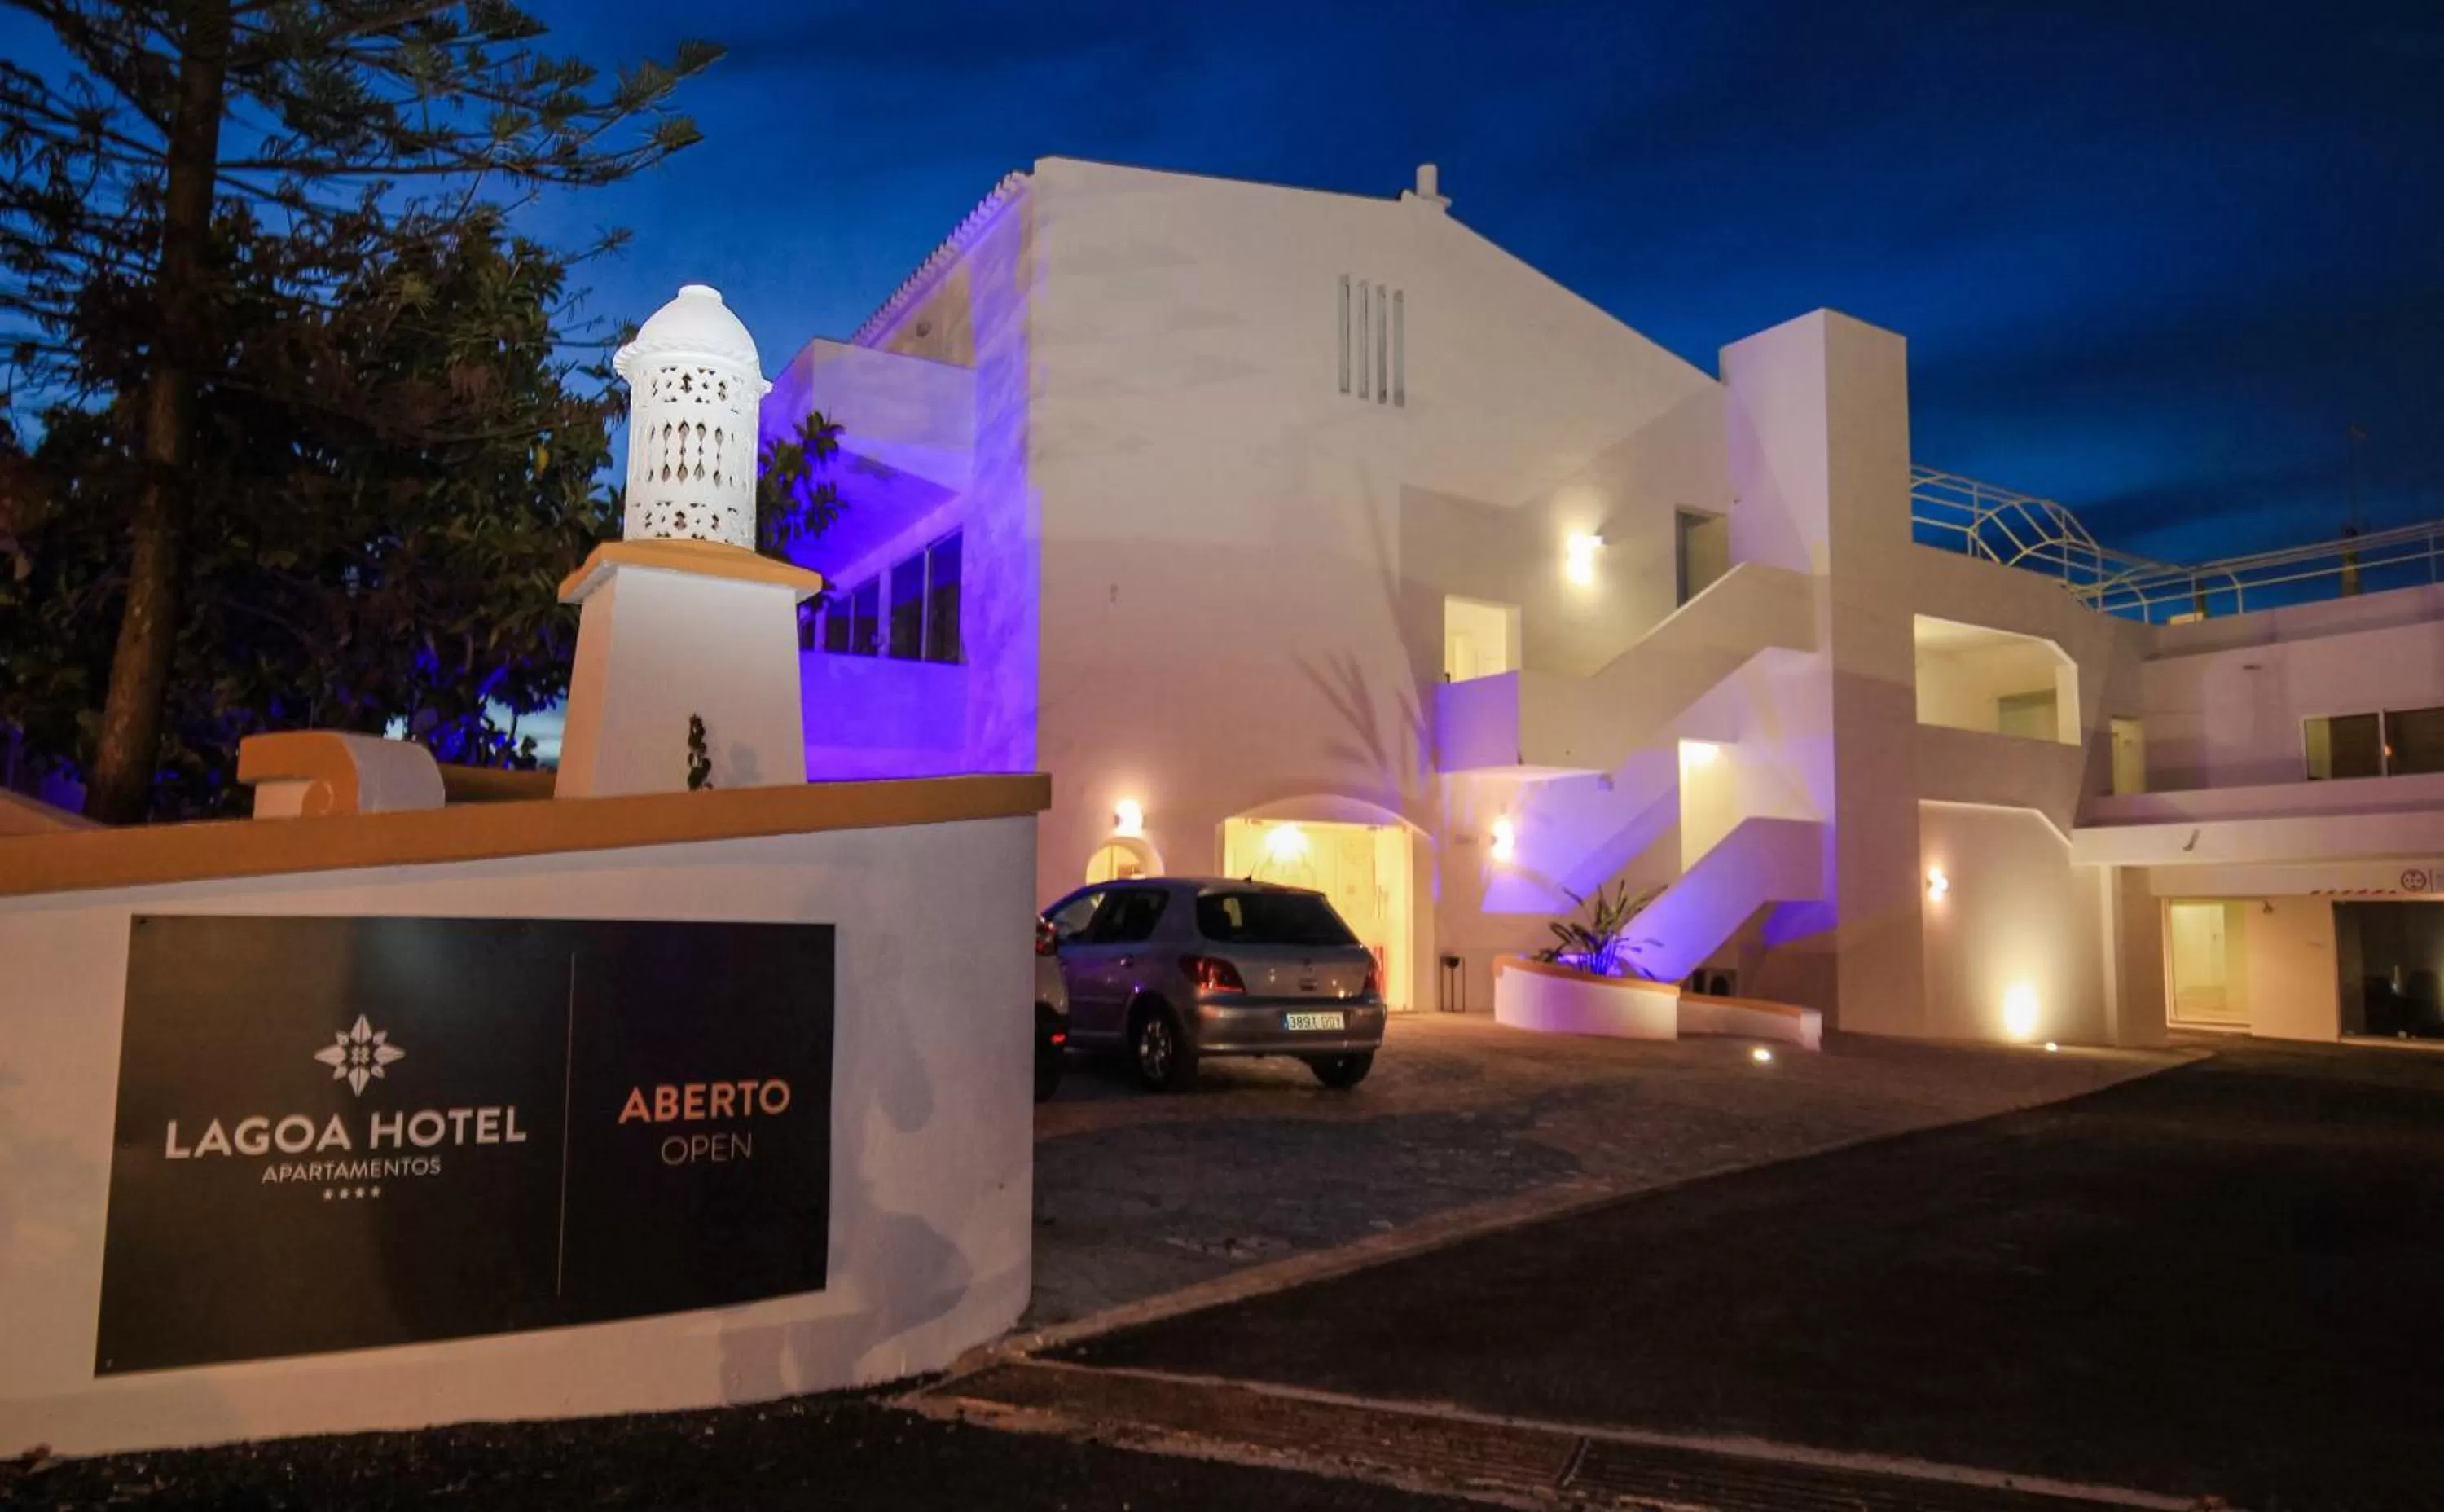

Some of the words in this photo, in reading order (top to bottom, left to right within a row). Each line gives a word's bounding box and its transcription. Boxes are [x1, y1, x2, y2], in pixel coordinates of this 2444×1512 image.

[618, 1079, 790, 1124] ABERTO
[165, 1113, 351, 1159] LAGOA
[370, 1105, 527, 1149] HOTEL
[661, 1131, 752, 1166] OPEN
[261, 1154, 441, 1184] APARTAMENTOS
